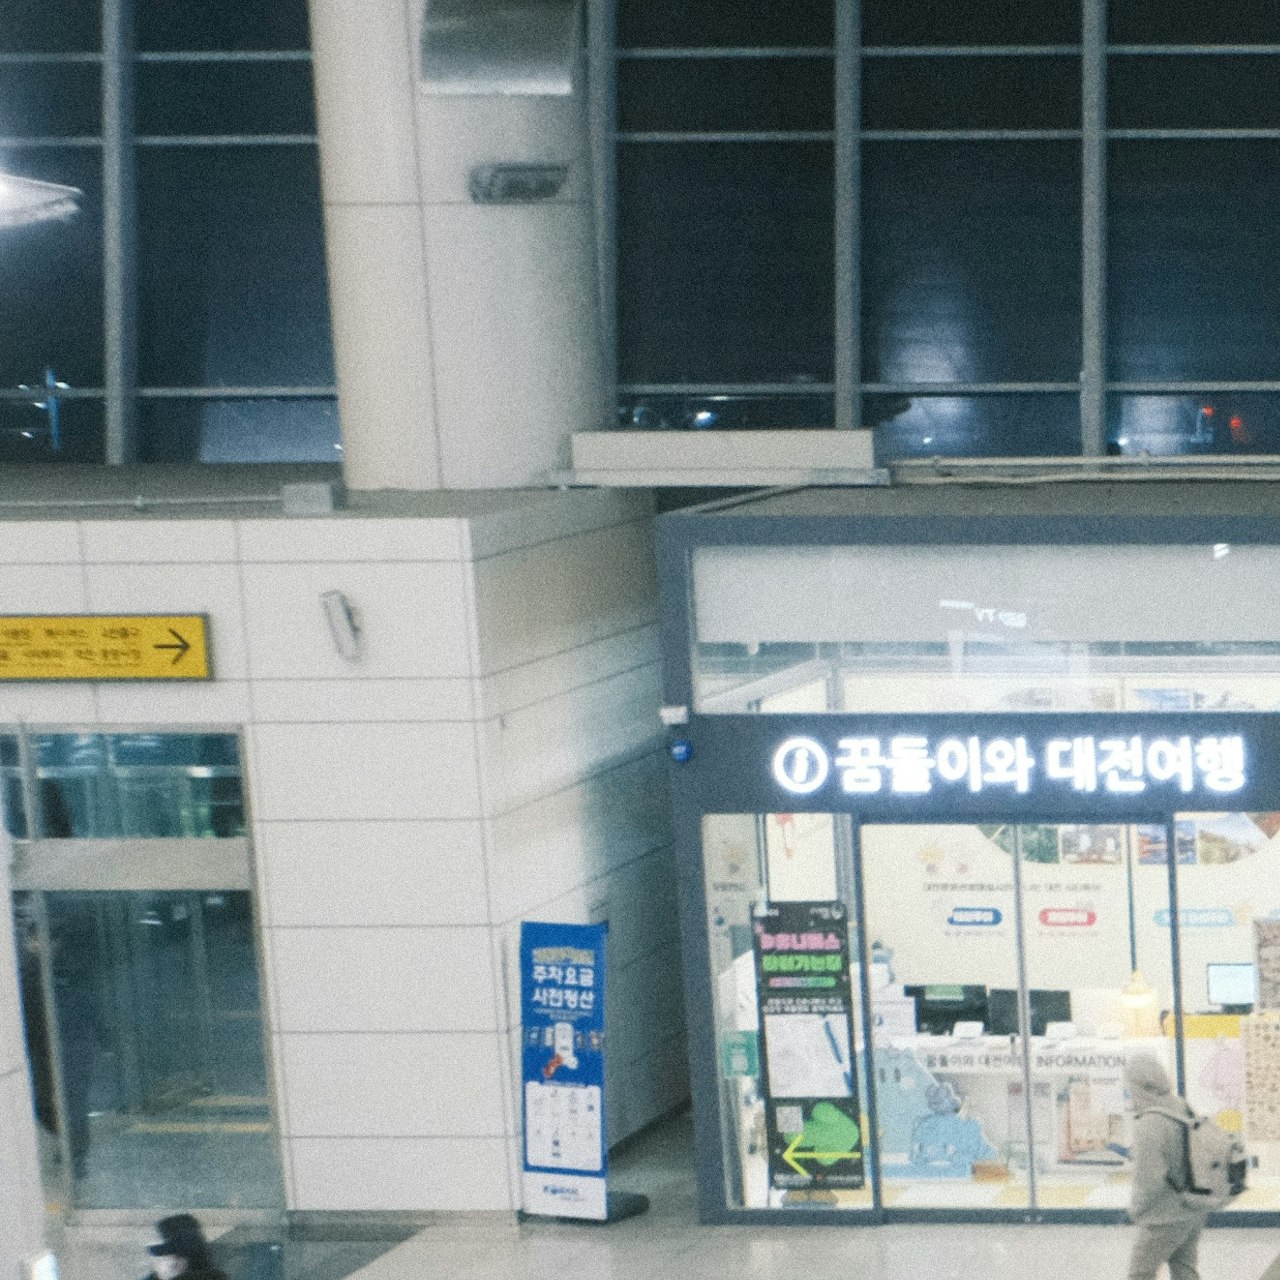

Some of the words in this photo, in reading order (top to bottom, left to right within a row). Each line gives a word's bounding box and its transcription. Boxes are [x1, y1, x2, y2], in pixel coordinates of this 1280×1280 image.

[835, 737, 1035, 793] 꿈돌이와
[1046, 736, 1246, 793] 대전여행
[533, 965, 595, 987] 주차요금
[532, 987, 595, 1009] 사전정산
[1036, 1055, 1126, 1067] INFORMATION
